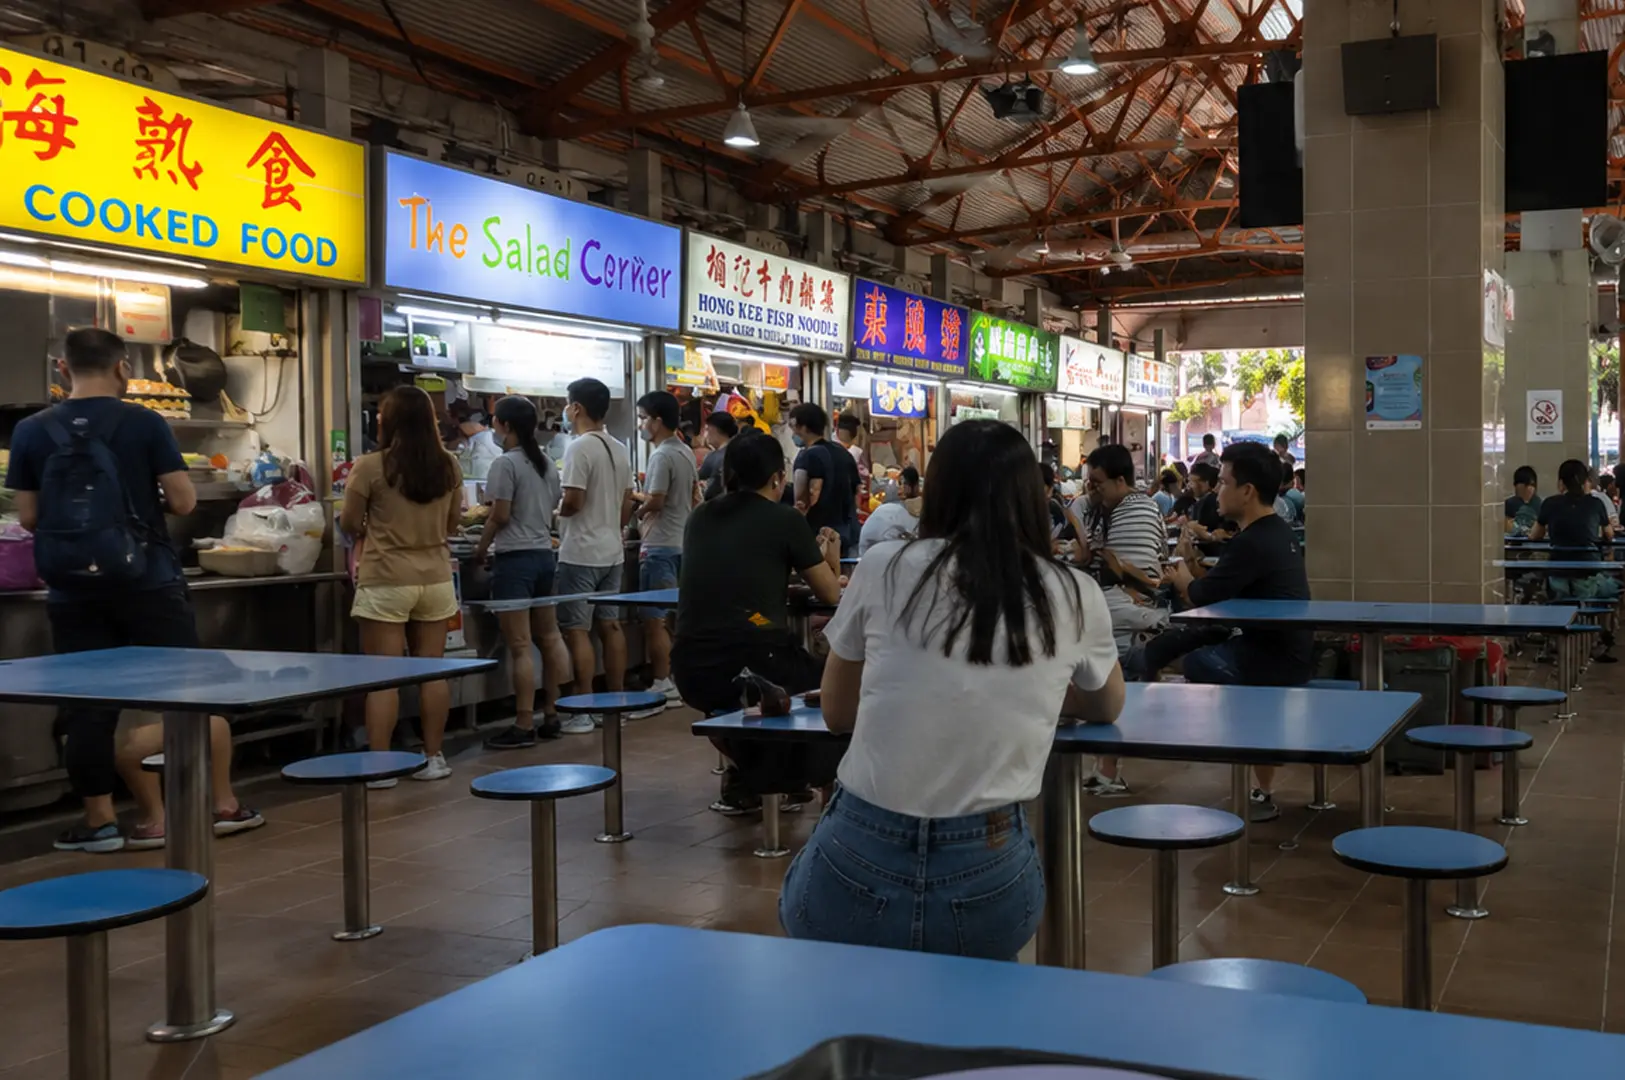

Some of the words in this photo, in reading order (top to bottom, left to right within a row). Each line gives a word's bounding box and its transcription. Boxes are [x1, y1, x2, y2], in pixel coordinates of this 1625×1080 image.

[24, 184, 219, 248] COOKED
[241, 223, 338, 267] FOOD
[398, 195, 469, 259] The
[481, 215, 571, 281] Salad
[698, 293, 735, 317] HONG
[738, 302, 763, 322] KEE
[767, 308, 794, 329] FISH
[797, 315, 839, 338] NOODLE
